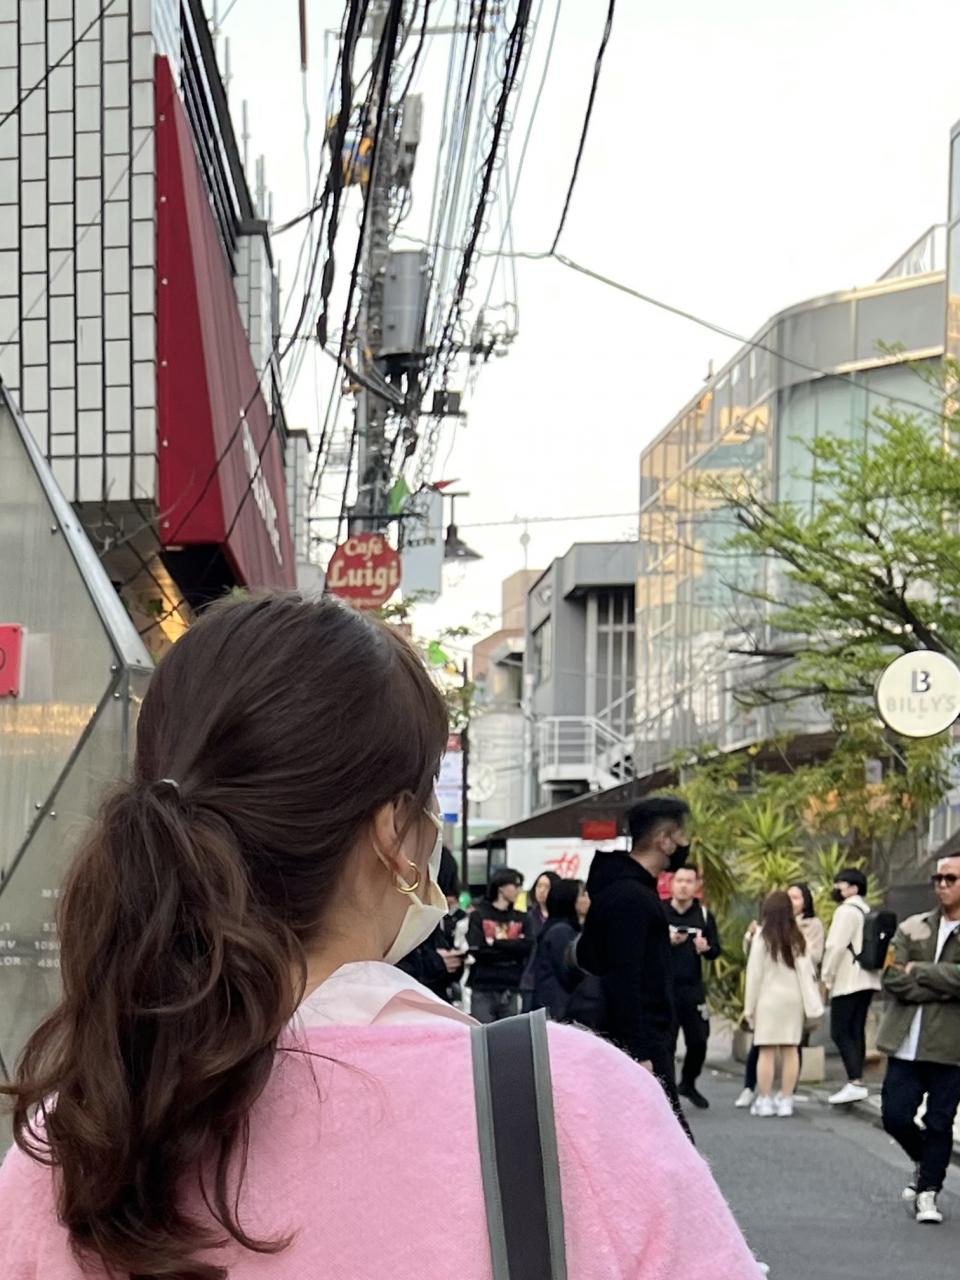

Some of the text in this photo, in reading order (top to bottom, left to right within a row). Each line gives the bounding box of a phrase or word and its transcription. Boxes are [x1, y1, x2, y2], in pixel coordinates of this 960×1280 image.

[327, 560, 400, 596] Luigi
[911, 670, 932, 693] B
[886, 694, 957, 713] BILLY'S
